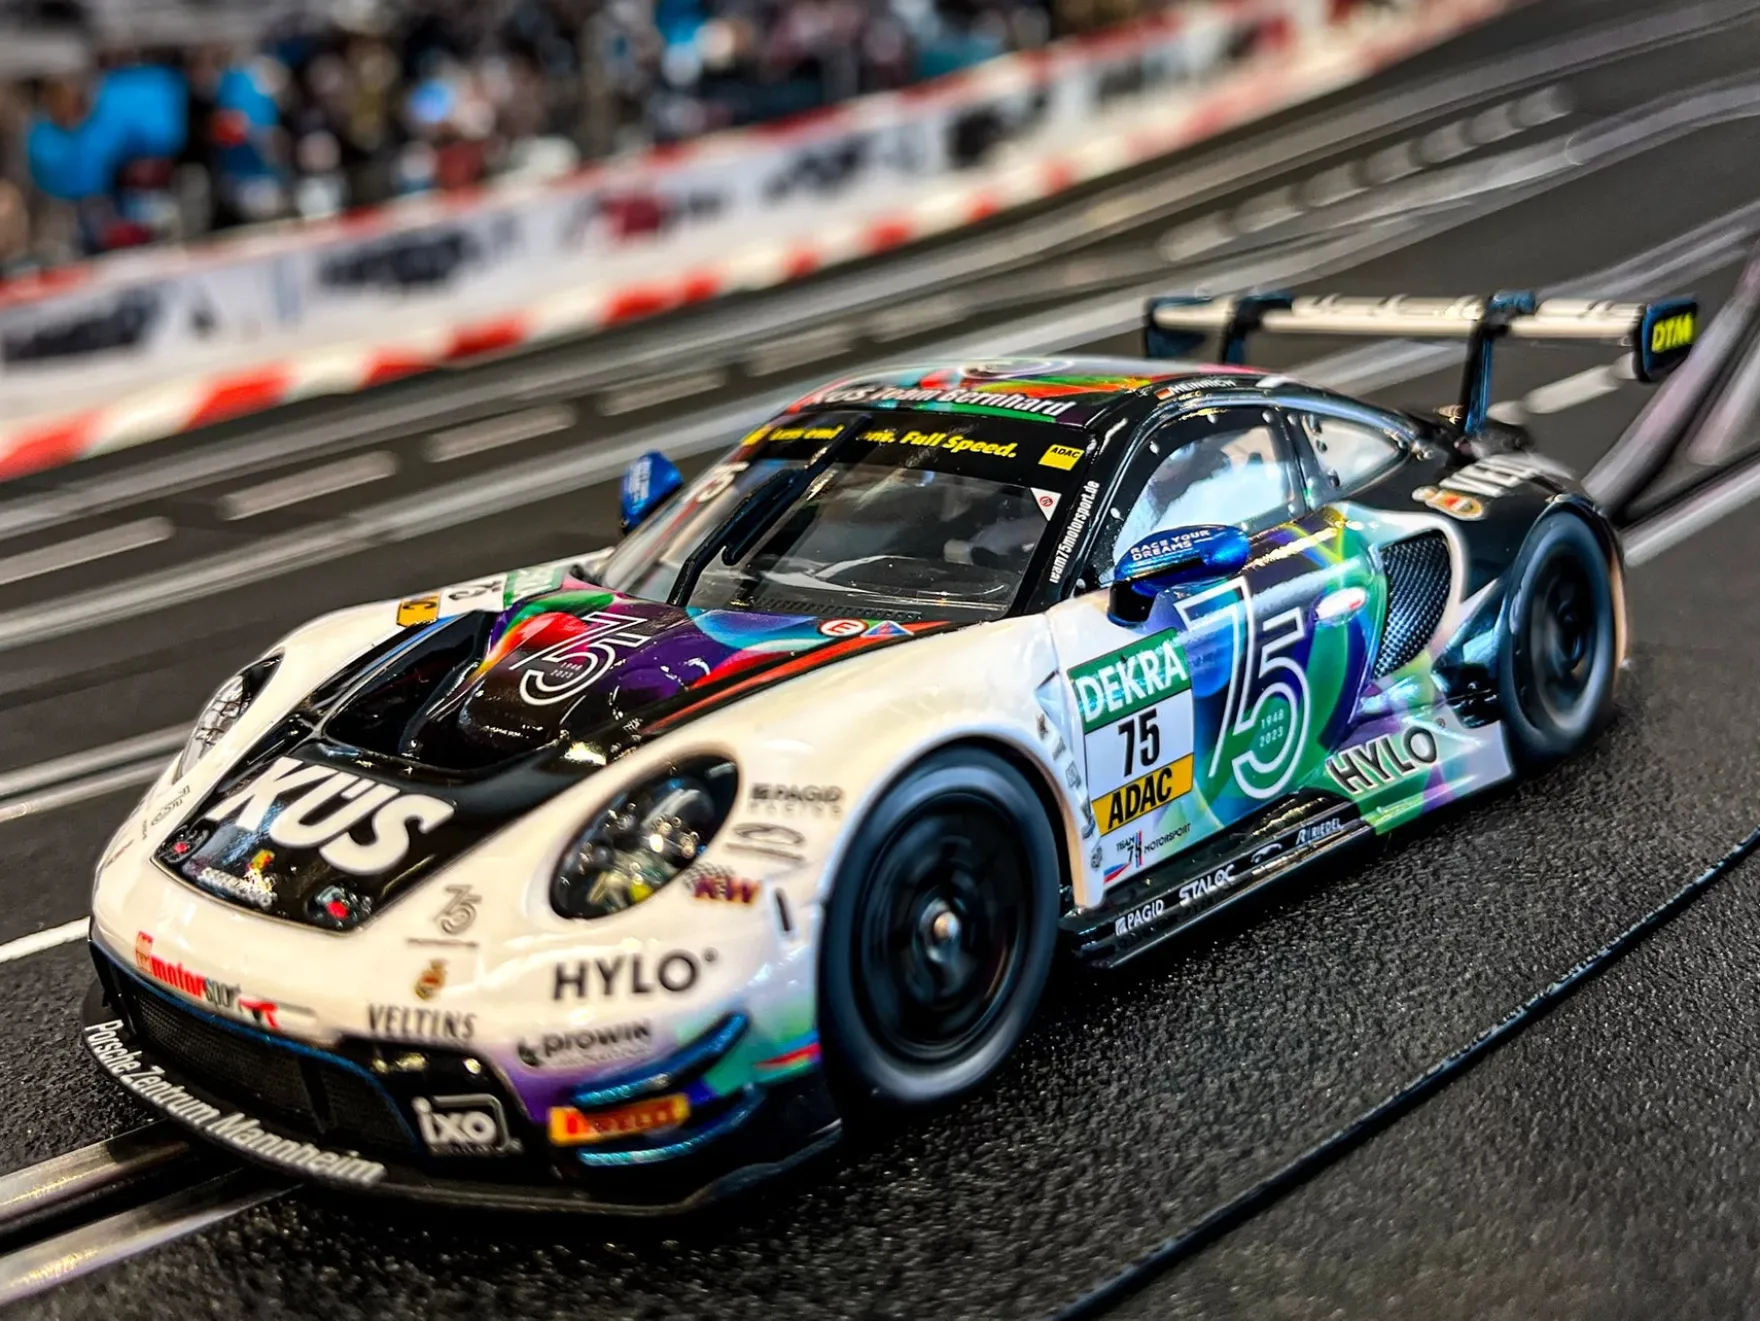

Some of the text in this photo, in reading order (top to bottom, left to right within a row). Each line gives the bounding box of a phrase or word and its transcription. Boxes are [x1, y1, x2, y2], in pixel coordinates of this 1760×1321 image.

[1651, 312, 1693, 354] DTM
[938, 388, 1078, 417] Bernhard
[899, 430, 946, 448] Full
[942, 432, 1018, 459] Speed.
[1049, 446, 1080, 459] ADAC
[1049, 480, 1100, 584] team75motorsport.de
[1130, 530, 1210, 555] RACE YOUR
[1132, 540, 1192, 561] DREAMS
[508, 611, 652, 706] 75
[1075, 640, 1188, 723] DEKRA
[1173, 575, 1310, 799] 75
[1261, 709, 1284, 729] 1948
[1118, 707, 1161, 777] 75
[1260, 726, 1283, 748] 2023
[774, 784, 844, 802] PAGID
[1107, 767, 1173, 830] ADAC
[205, 756, 454, 875] KÜS
[1310, 817, 1343, 838] RIEDEL
[1116, 836, 1135, 851] TEAM
[1144, 822, 1191, 854] MOTORSPORT
[1178, 864, 1236, 906] STALOC
[1126, 899, 1165, 930] PAGID
[368, 1003, 477, 1040] VELTINS
[84, 1019, 387, 1187] Porsche Zentrum Mannheim
[411, 1096, 497, 1144] ixo
